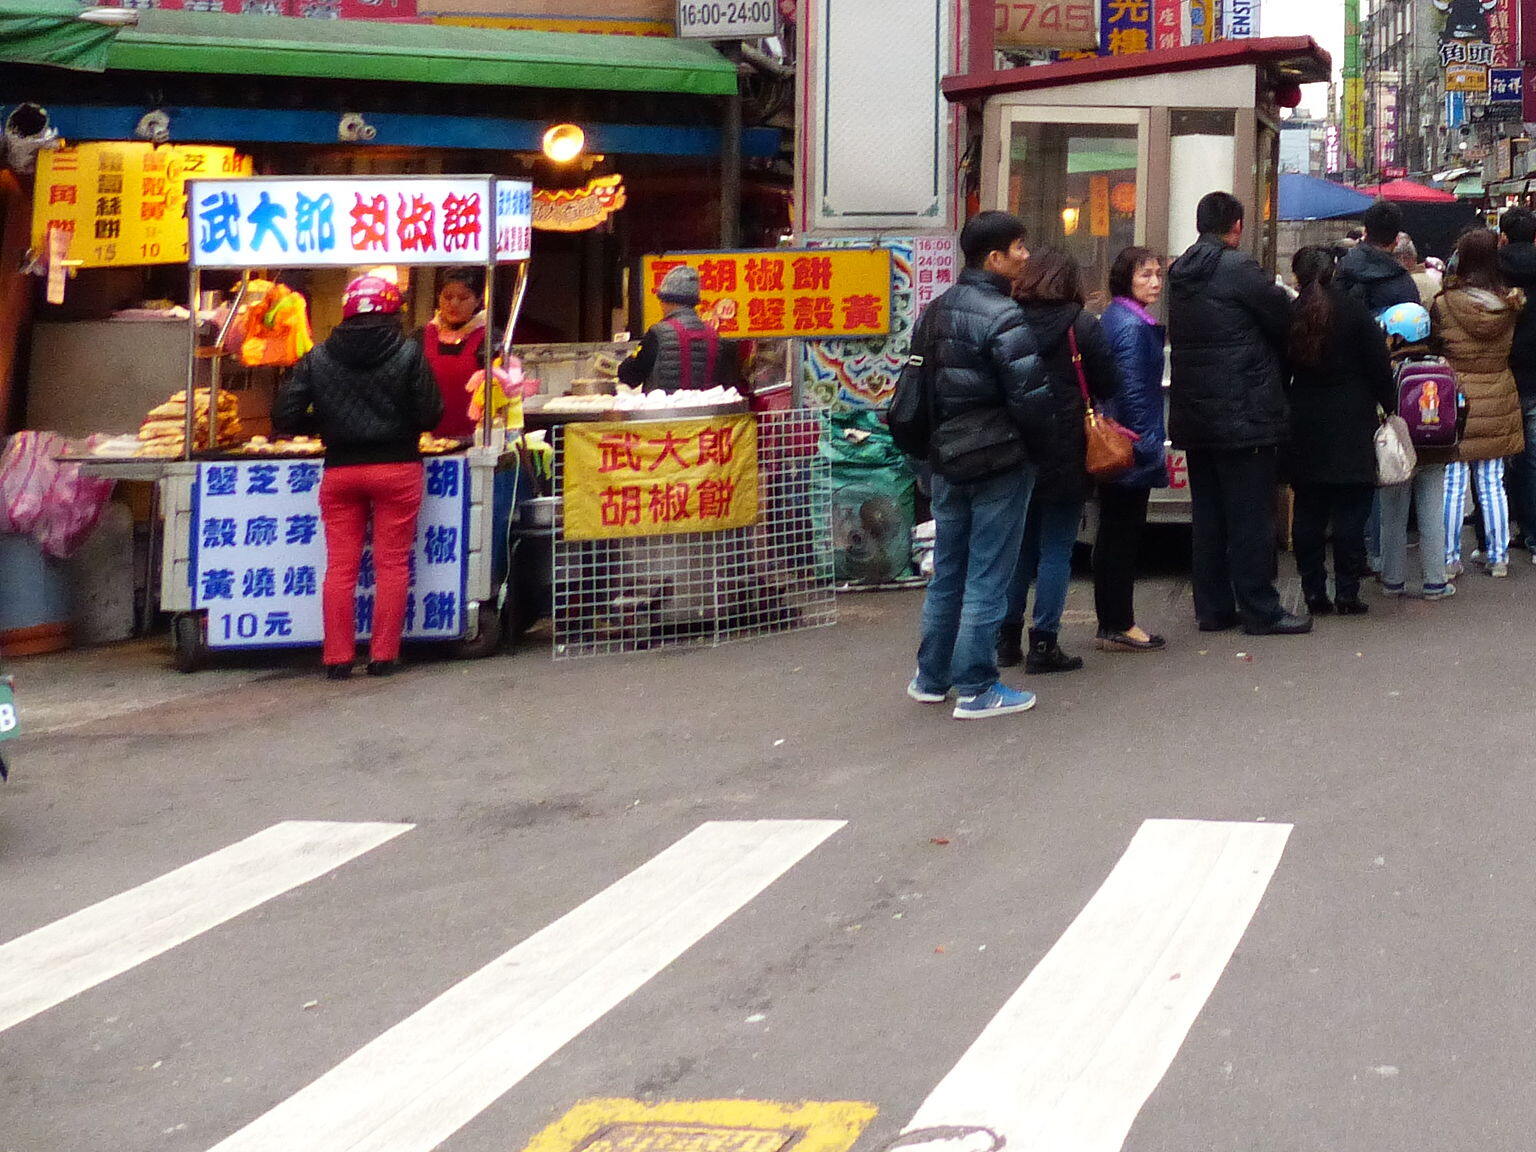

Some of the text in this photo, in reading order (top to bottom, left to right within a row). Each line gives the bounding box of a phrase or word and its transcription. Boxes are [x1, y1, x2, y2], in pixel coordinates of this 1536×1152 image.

[682, 1, 771, 27] 16:00-24:00
[200, 190, 337, 254] 武大郎
[348, 191, 483, 255] 胡椒餅
[919, 255, 952, 267] 24:00
[598, 425, 735, 474] 武大郎
[600, 476, 735, 528] 胡椒餅
[202, 466, 239, 602] 蟹殼黃
[242, 464, 280, 599] 芝麻燒
[421, 459, 460, 631] 胡椒餅
[220, 611, 293, 641] 10元
